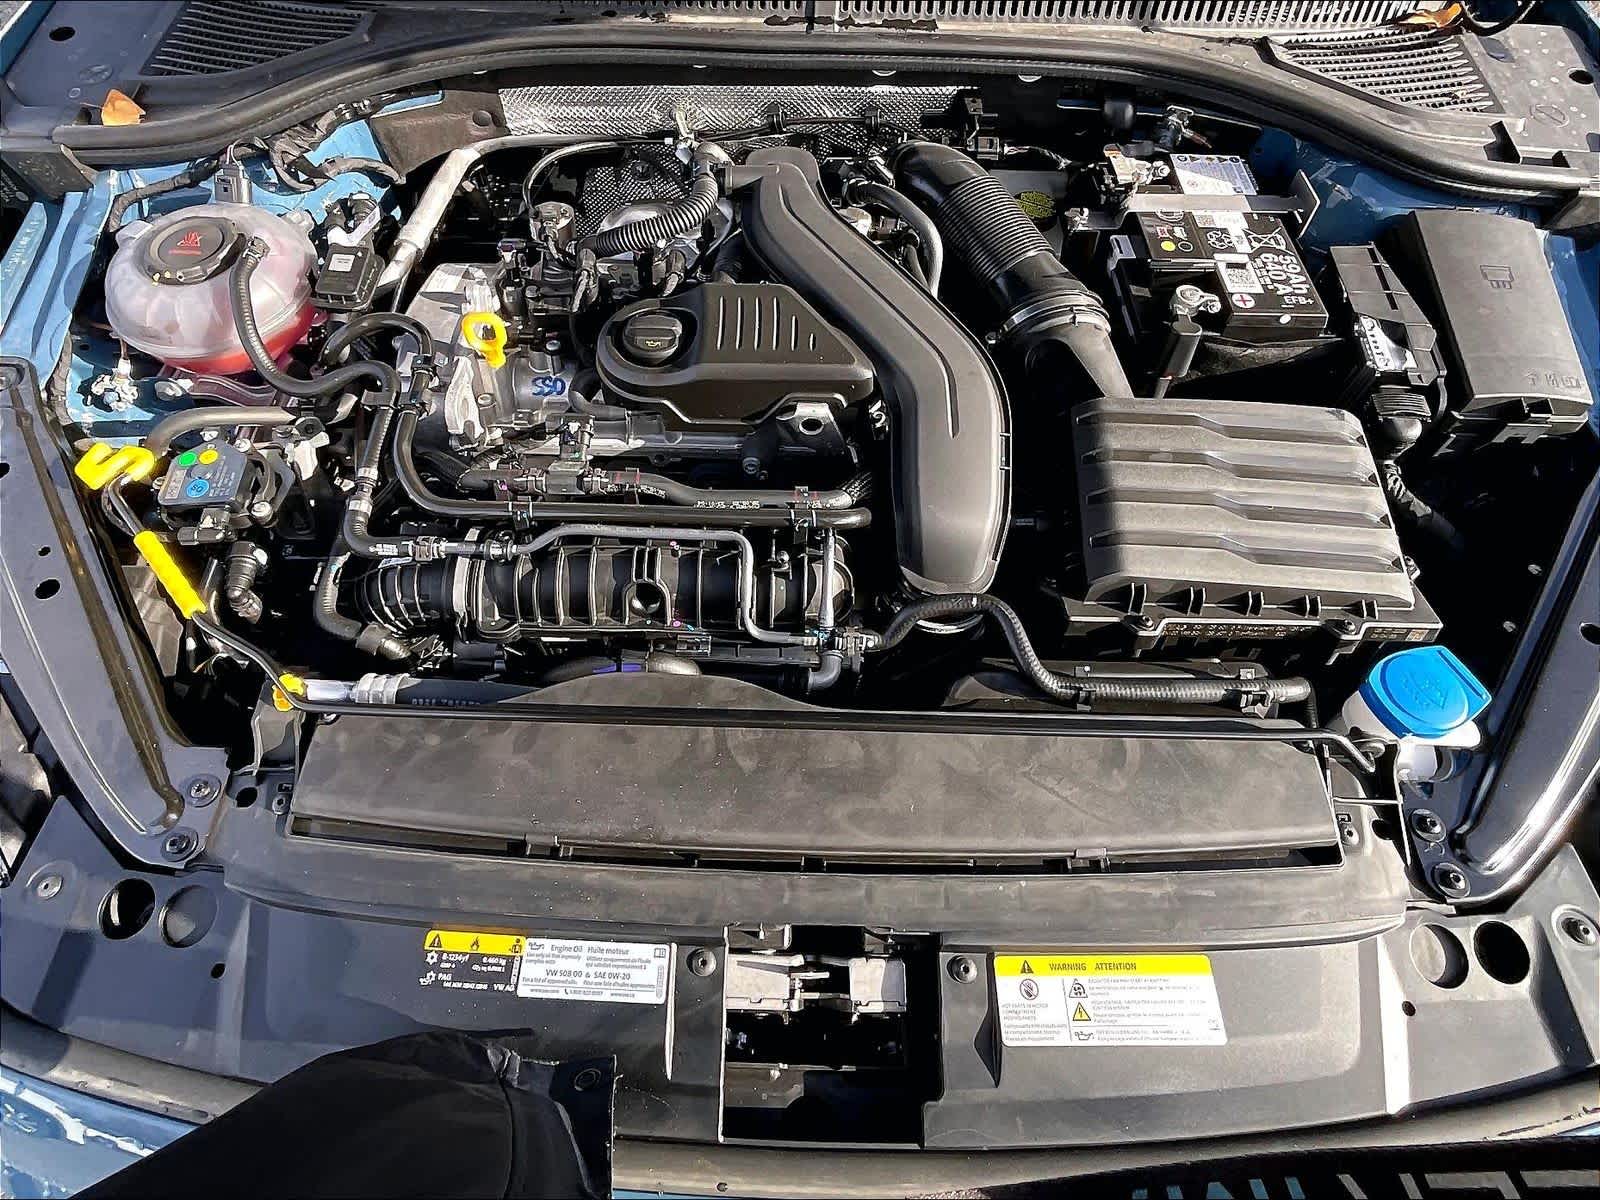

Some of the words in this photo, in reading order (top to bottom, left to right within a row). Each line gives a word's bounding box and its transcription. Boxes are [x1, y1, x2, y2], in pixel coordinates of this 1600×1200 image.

[1278, 254, 1311, 294] 59Ah
[551, 944, 573, 953] Engine
[573, 945, 583, 953] Oil
[587, 946, 605, 954] Huile
[606, 947, 630, 955] moteur
[1048, 962, 1087, 971] WARNING
[1094, 962, 1137, 971] ATTENTION
[546, 968, 558, 977] VW
[573, 970, 583, 978] 00
[593, 971, 606, 979] SAE
[607, 972, 631, 980] 0W-20
